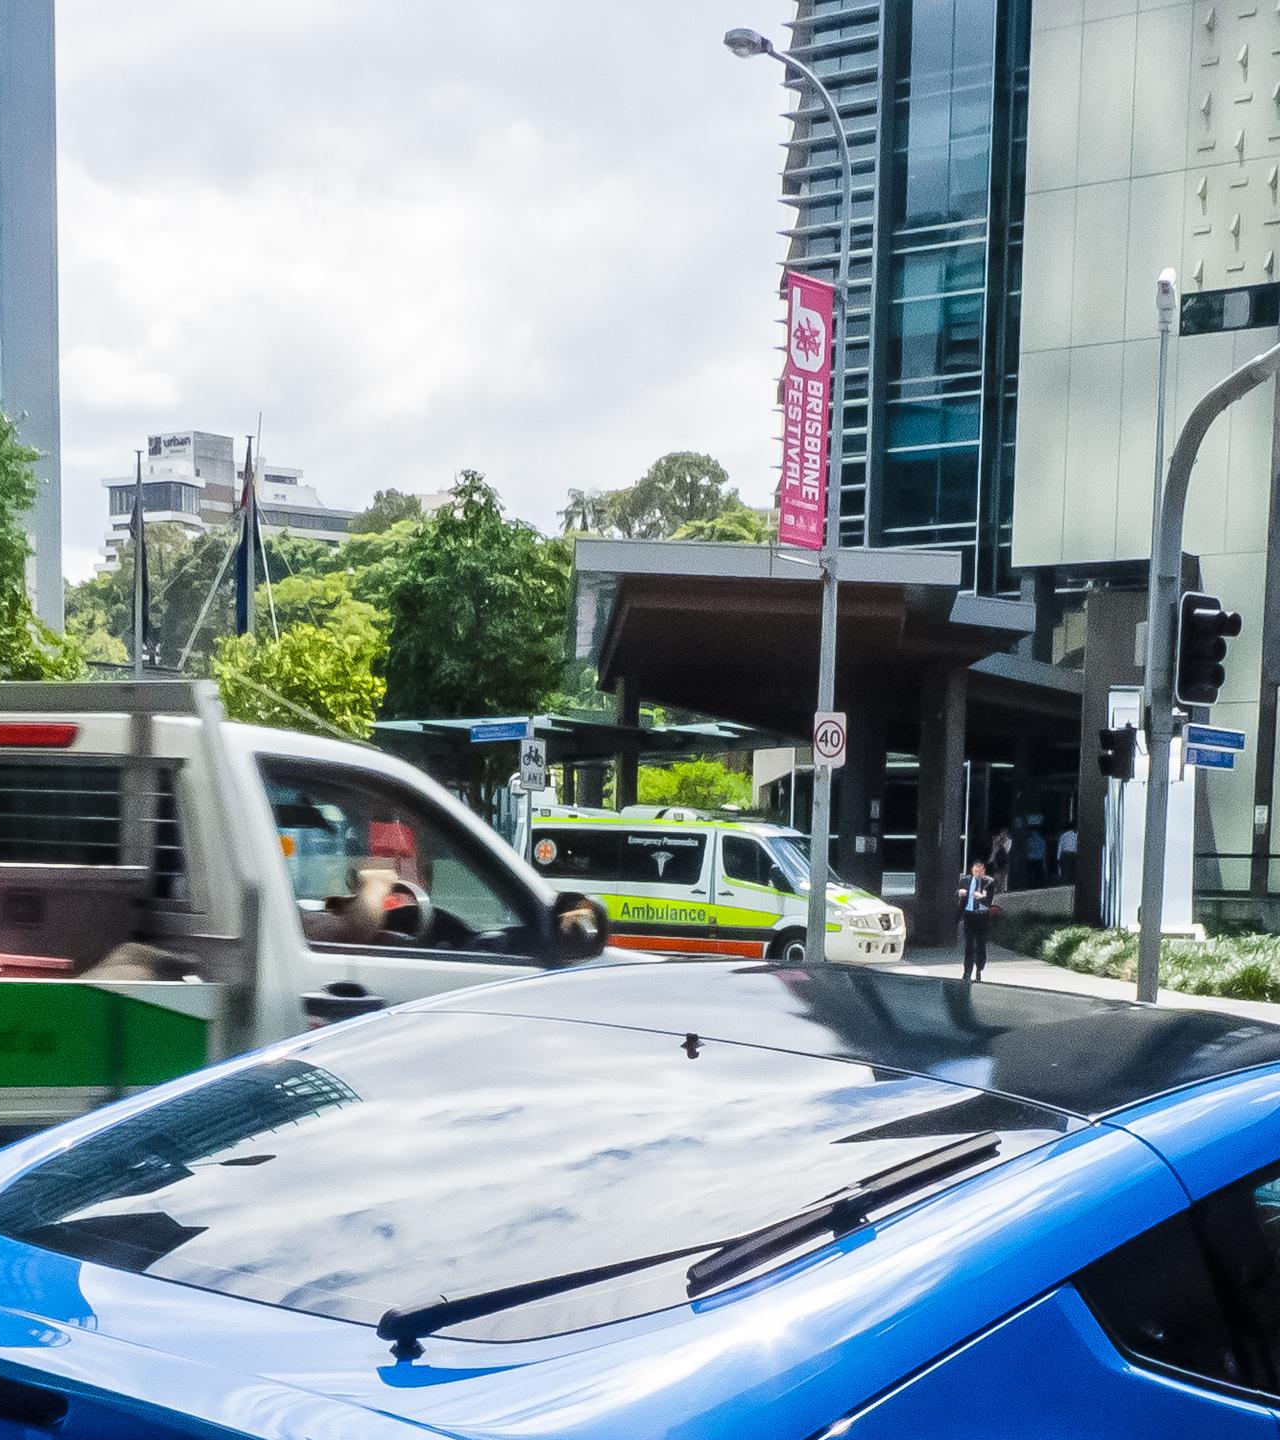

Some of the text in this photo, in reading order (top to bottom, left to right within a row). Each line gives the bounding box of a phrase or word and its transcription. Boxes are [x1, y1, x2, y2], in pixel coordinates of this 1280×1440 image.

[163, 436, 191, 447] urban
[785, 375, 803, 490] FESTIVAL
[802, 380, 823, 500] BRISBANE
[819, 729, 841, 748] 40
[621, 902, 706, 922] Ambulance
